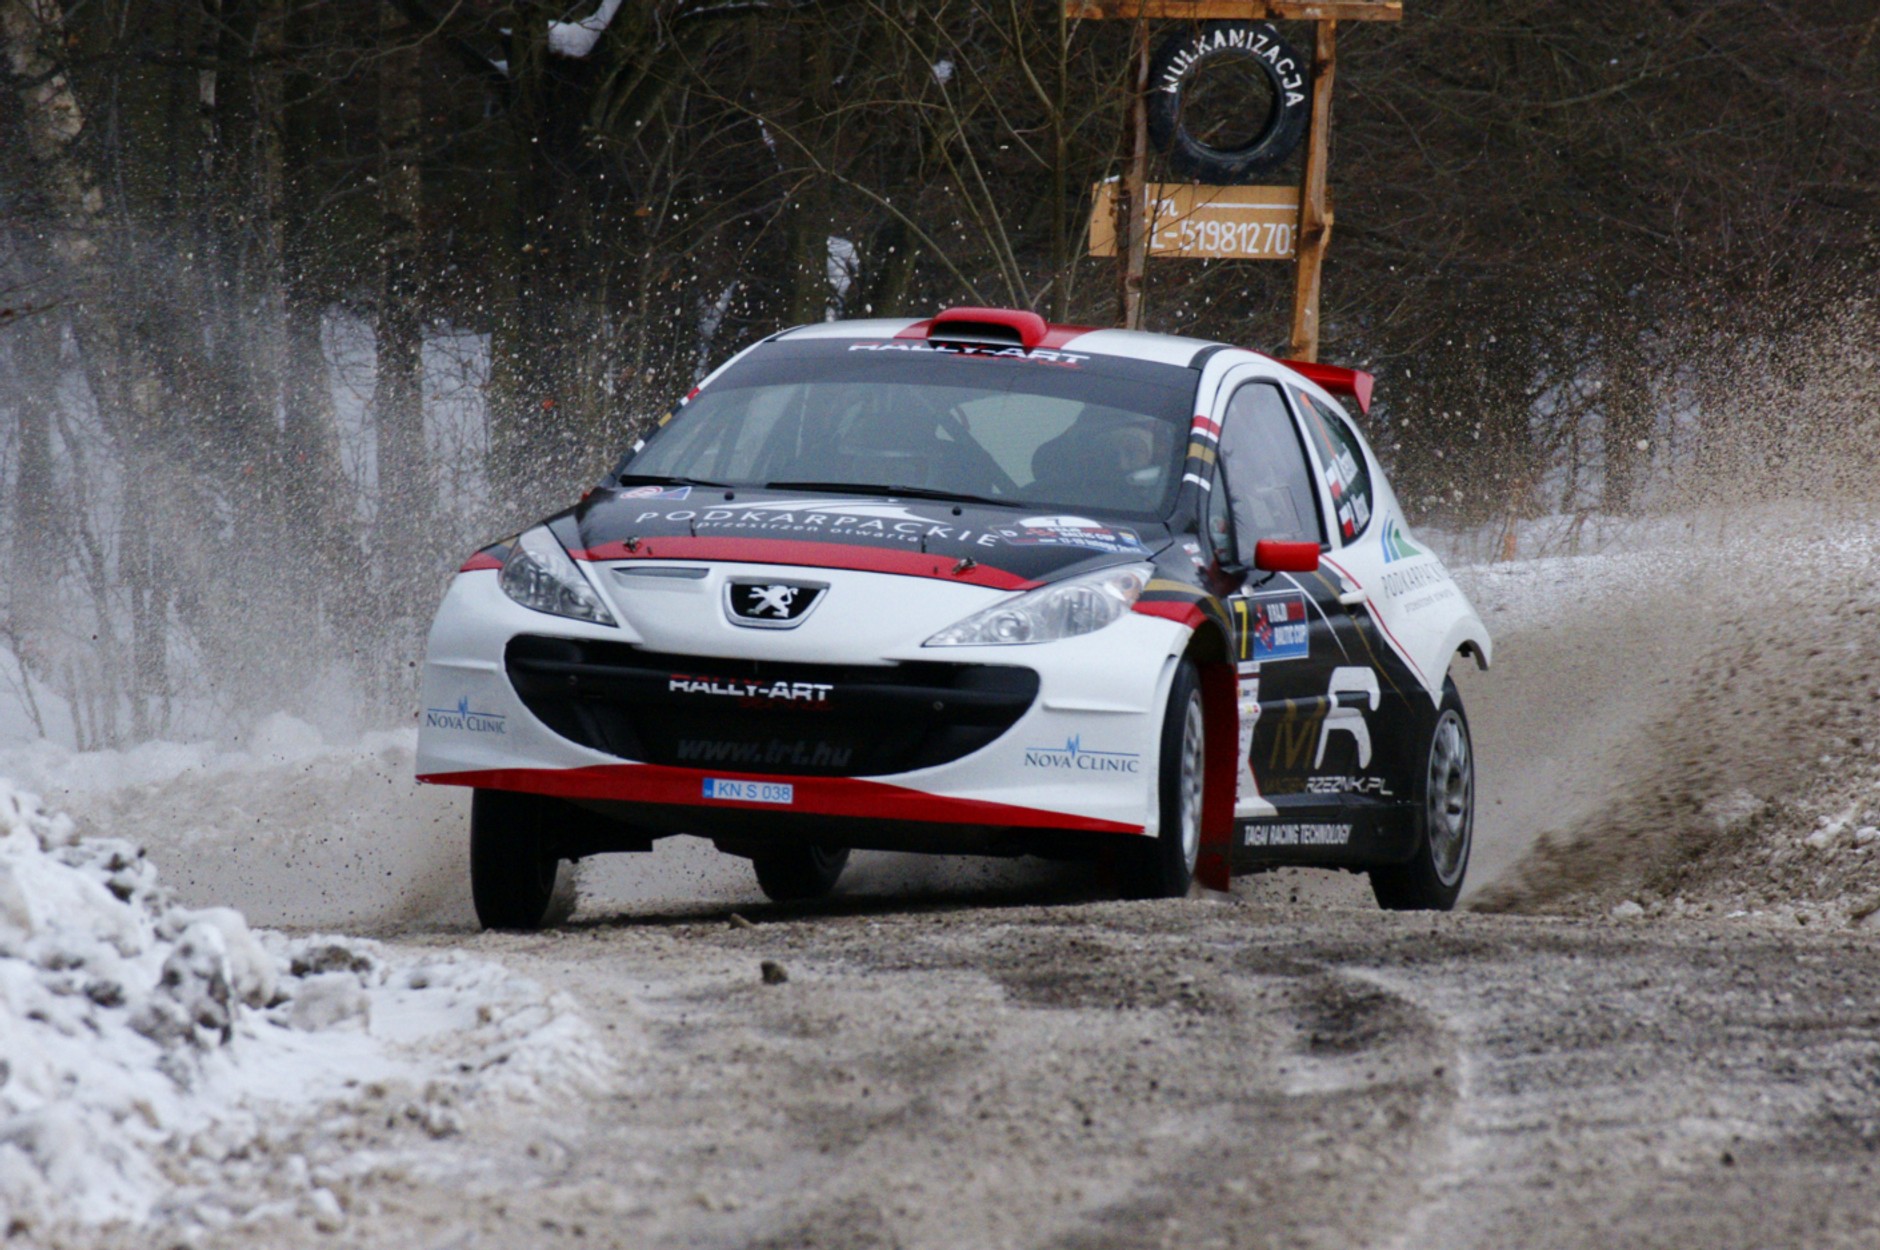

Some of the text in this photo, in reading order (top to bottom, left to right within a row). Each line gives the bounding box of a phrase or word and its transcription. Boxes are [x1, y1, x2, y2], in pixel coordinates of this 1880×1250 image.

[1160, 28, 1305, 108] WULKANIZACJA
[848, 341, 1090, 364] RALLY-ART
[635, 510, 1000, 548] PODKARPACKIE
[1234, 601, 1248, 660] 7
[669, 674, 834, 701] RALLY-ART
[426, 713, 506, 734] NOVA CLINIC
[1024, 753, 1139, 773] NOVA CLINIC
[718, 782, 742, 797] KN
[745, 784, 757, 799] S
[762, 785, 791, 801] 038
